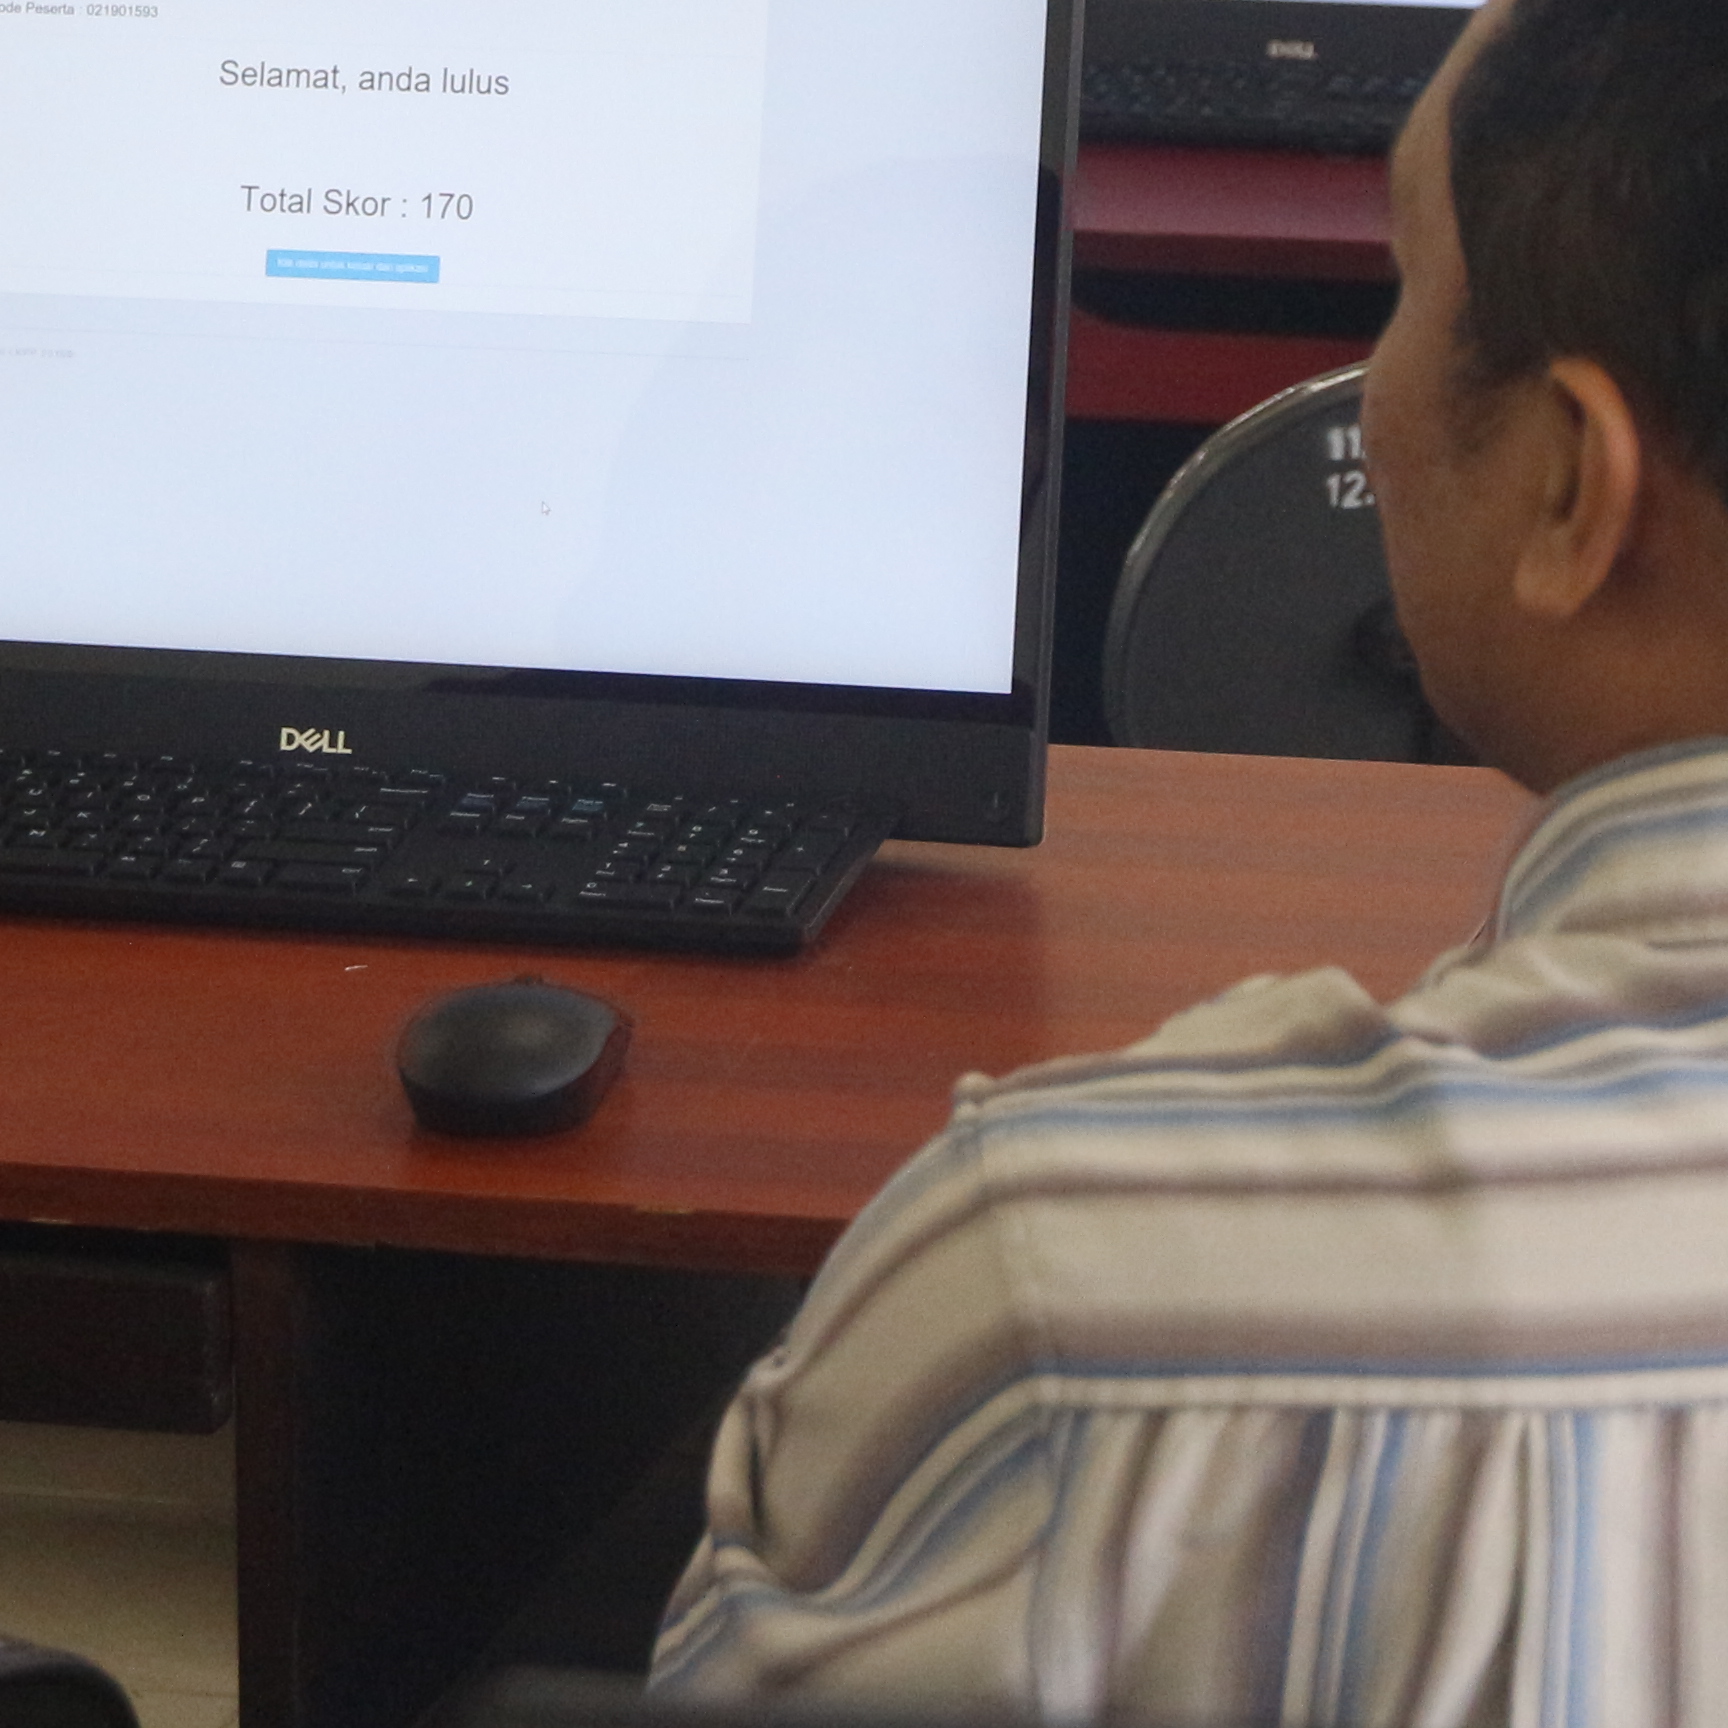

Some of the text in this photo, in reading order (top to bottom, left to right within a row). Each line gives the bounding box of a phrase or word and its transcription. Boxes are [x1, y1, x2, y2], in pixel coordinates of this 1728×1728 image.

[25, 1, 75, 16] Peserta
[218, 59, 511, 96] Selamat, anda lulus
[239, 184, 313, 215] Total
[322, 188, 392, 217] Skor
[420, 191, 474, 221] 170
[279, 726, 353, 755] DELL
